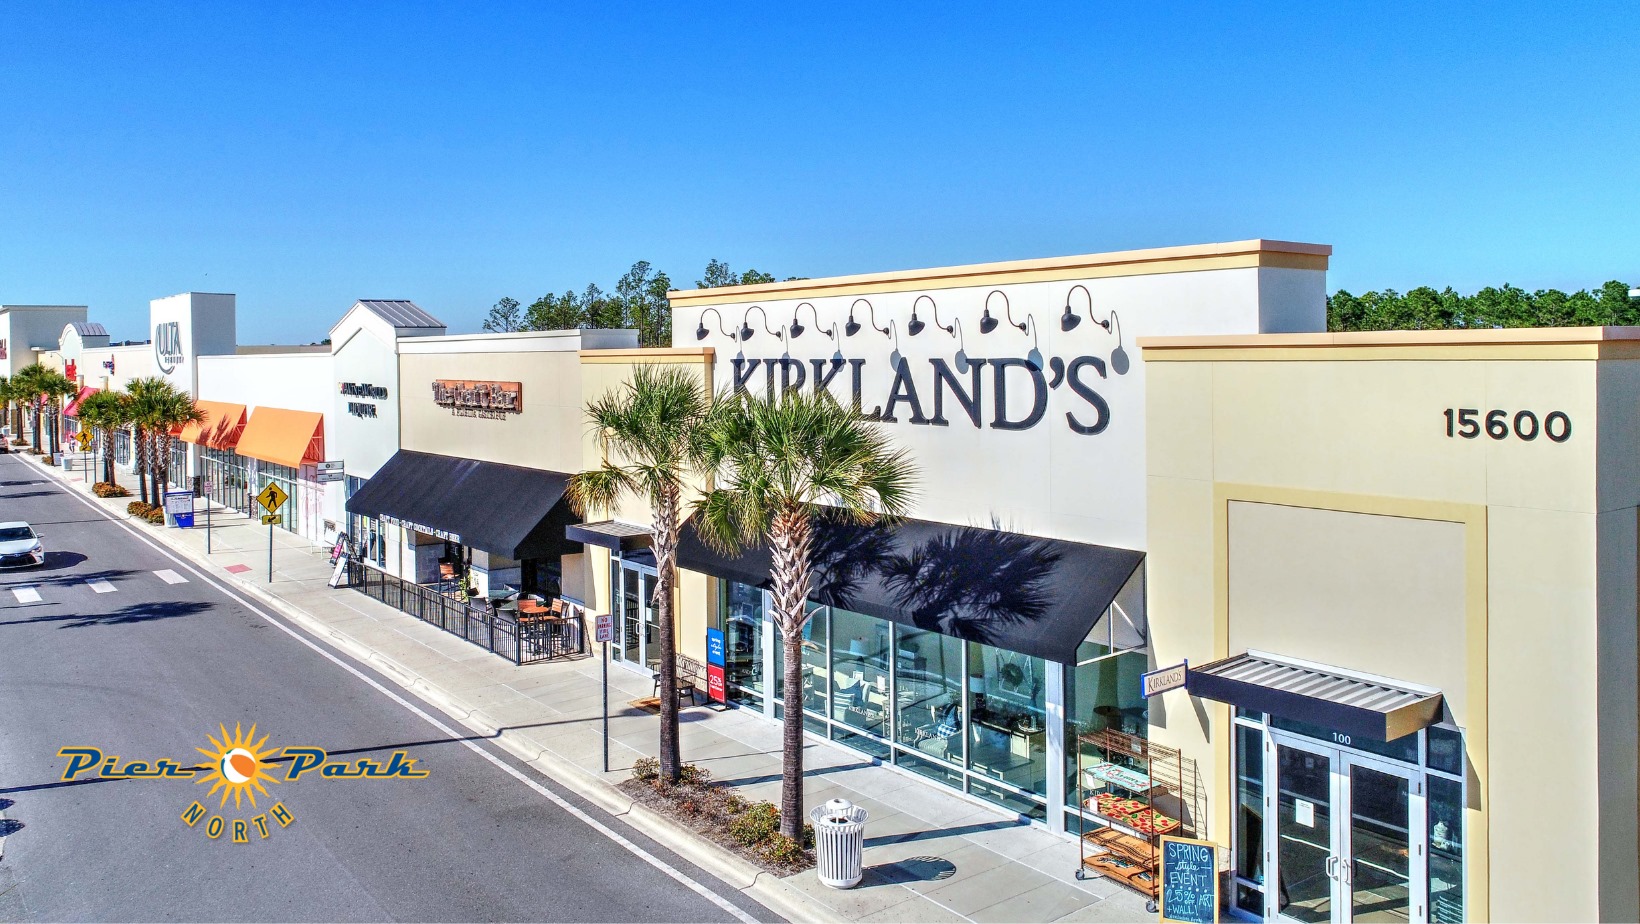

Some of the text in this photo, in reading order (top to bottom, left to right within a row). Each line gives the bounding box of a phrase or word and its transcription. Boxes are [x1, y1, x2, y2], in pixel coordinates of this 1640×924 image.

[158, 321, 182, 356] ULTA
[729, 356, 1110, 436] KIRKLAND'S
[1443, 408, 1573, 443] 15600
[1147, 669, 1183, 693] KIRKLAND'S
[1332, 732, 1351, 745] 100
[1168, 843, 1209, 862] SPRING
[1174, 860, 1200, 873] style
[1169, 872, 1208, 887] EVENT
[1166, 889, 1196, 903] 25%
